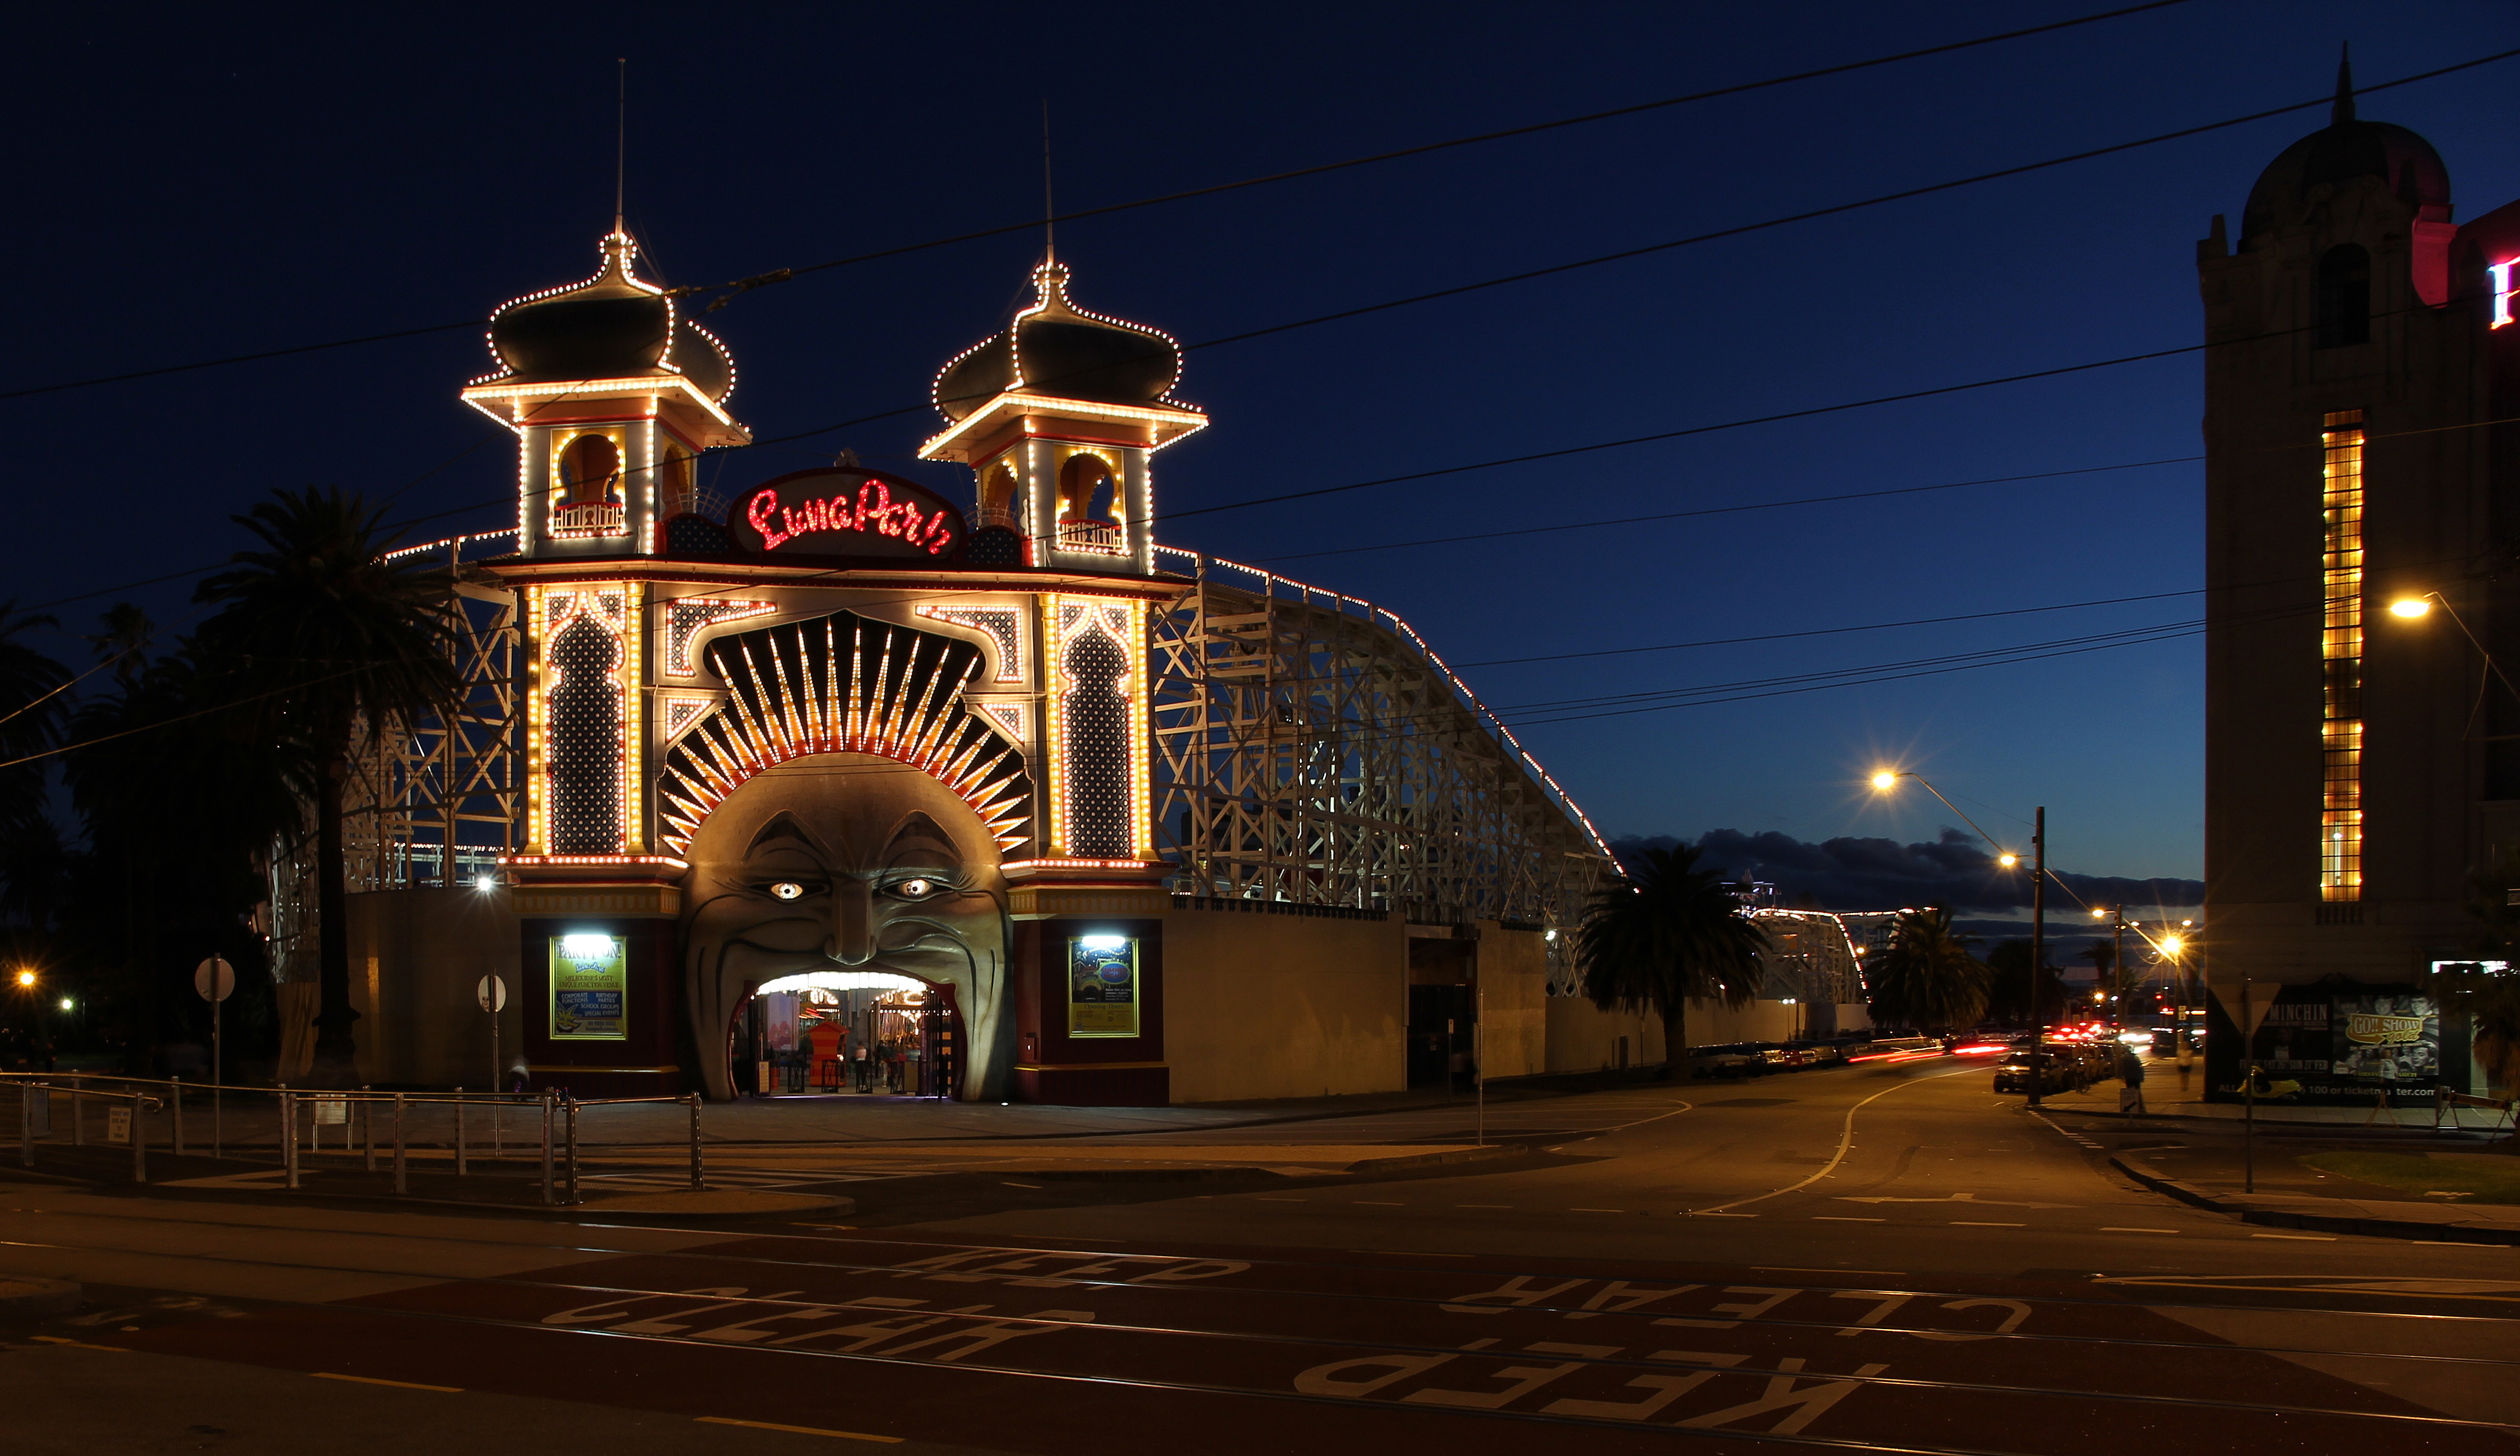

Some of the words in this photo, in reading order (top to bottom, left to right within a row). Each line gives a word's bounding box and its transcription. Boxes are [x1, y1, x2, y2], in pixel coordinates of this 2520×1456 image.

[748, 488, 852, 550] Luna
[853, 479, 952, 554] Park
[2268, 1003, 2328, 1021] MINCHIN
[2354, 1017, 2379, 1034] GO!!
[2382, 1018, 2420, 1032] SHOW
[2386, 1028, 2420, 1044] gold
[2314, 1059, 2328, 1070] FEB
[2309, 1086, 2328, 1094] 100
[2344, 1085, 2435, 1096] ticketmater.com
[845, 1248, 1252, 1291] KEEP
[1438, 1274, 2033, 1342] CLEAR
[541, 1286, 1097, 1362] CLEAR
[1292, 1337, 1892, 1437] KEEP
